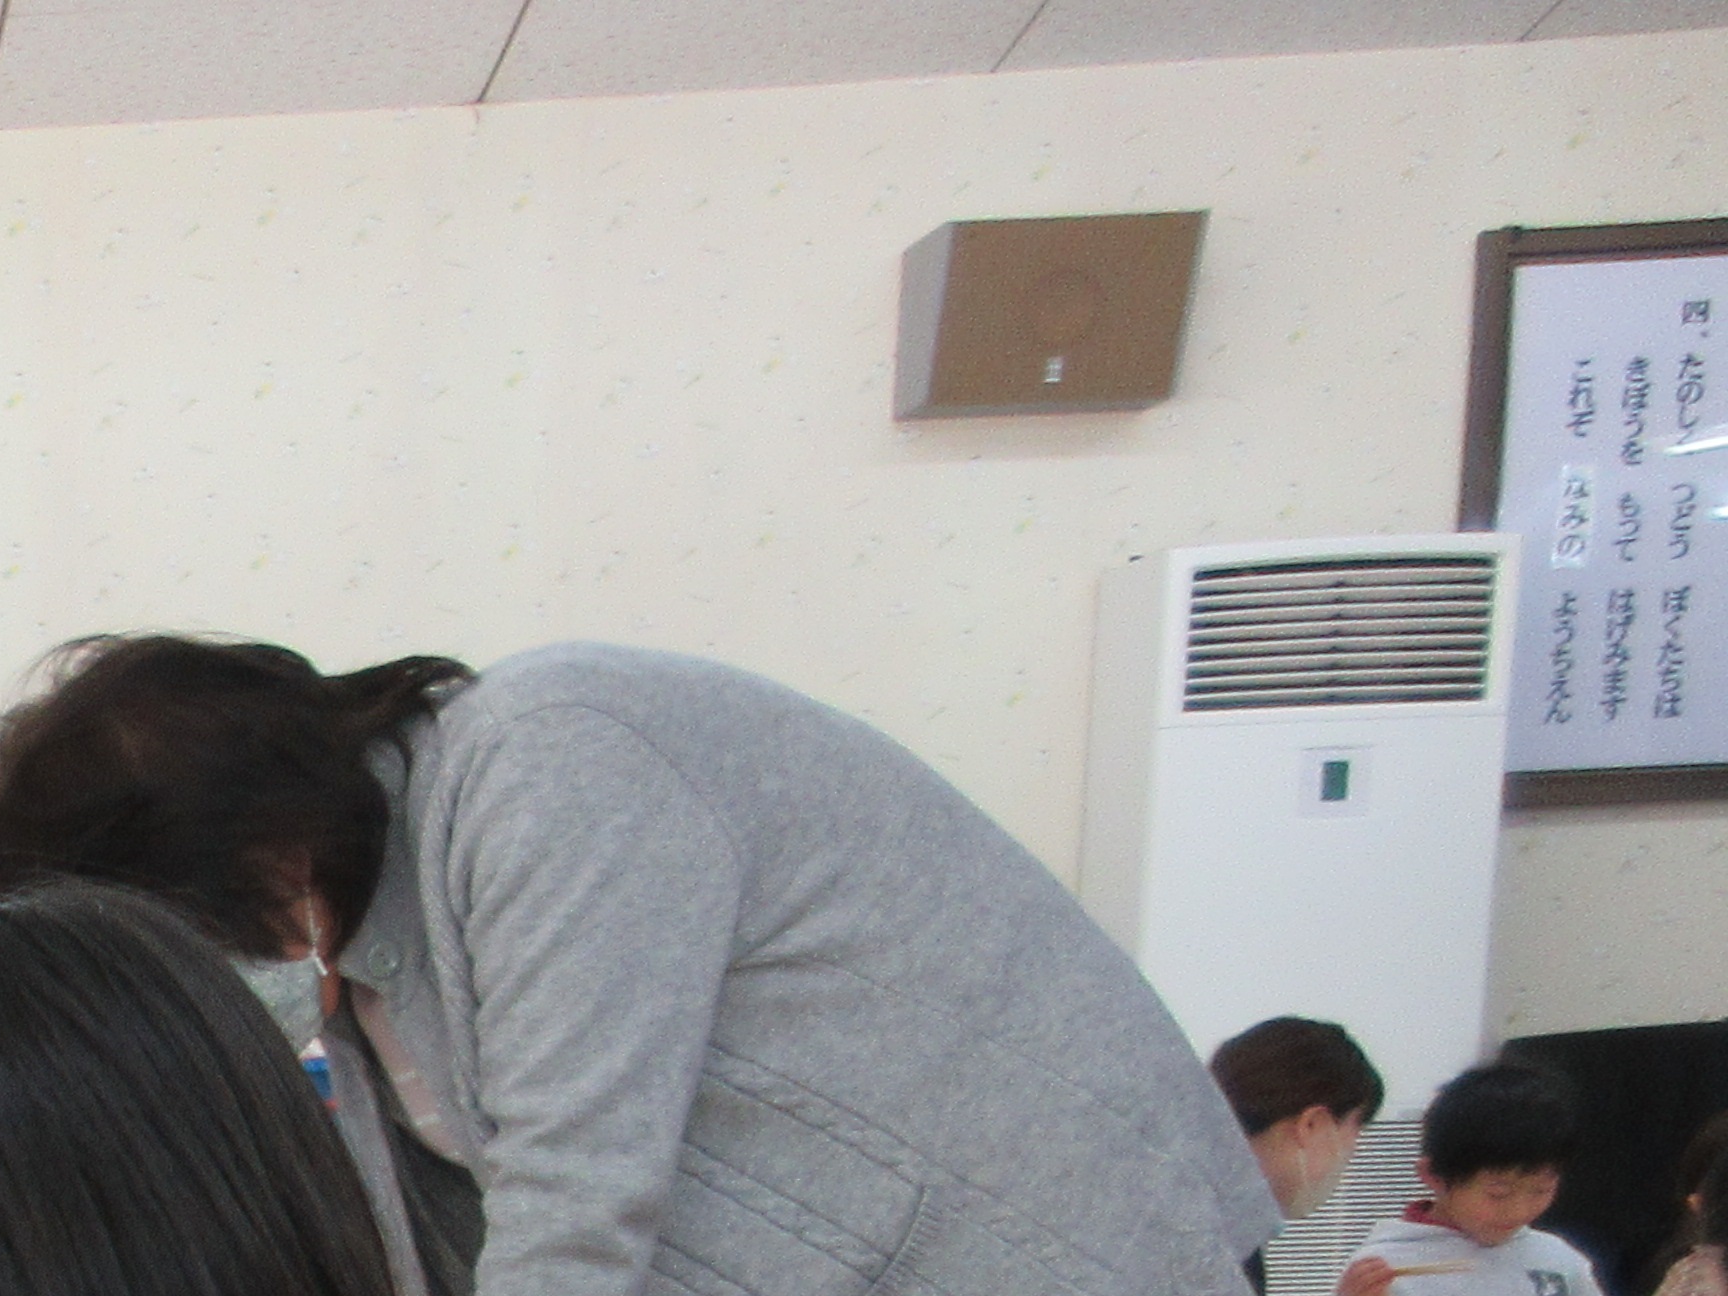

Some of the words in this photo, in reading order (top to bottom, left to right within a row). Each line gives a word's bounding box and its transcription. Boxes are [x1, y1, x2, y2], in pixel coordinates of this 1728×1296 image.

[1654, 585, 1692, 719] ぼくたちは
